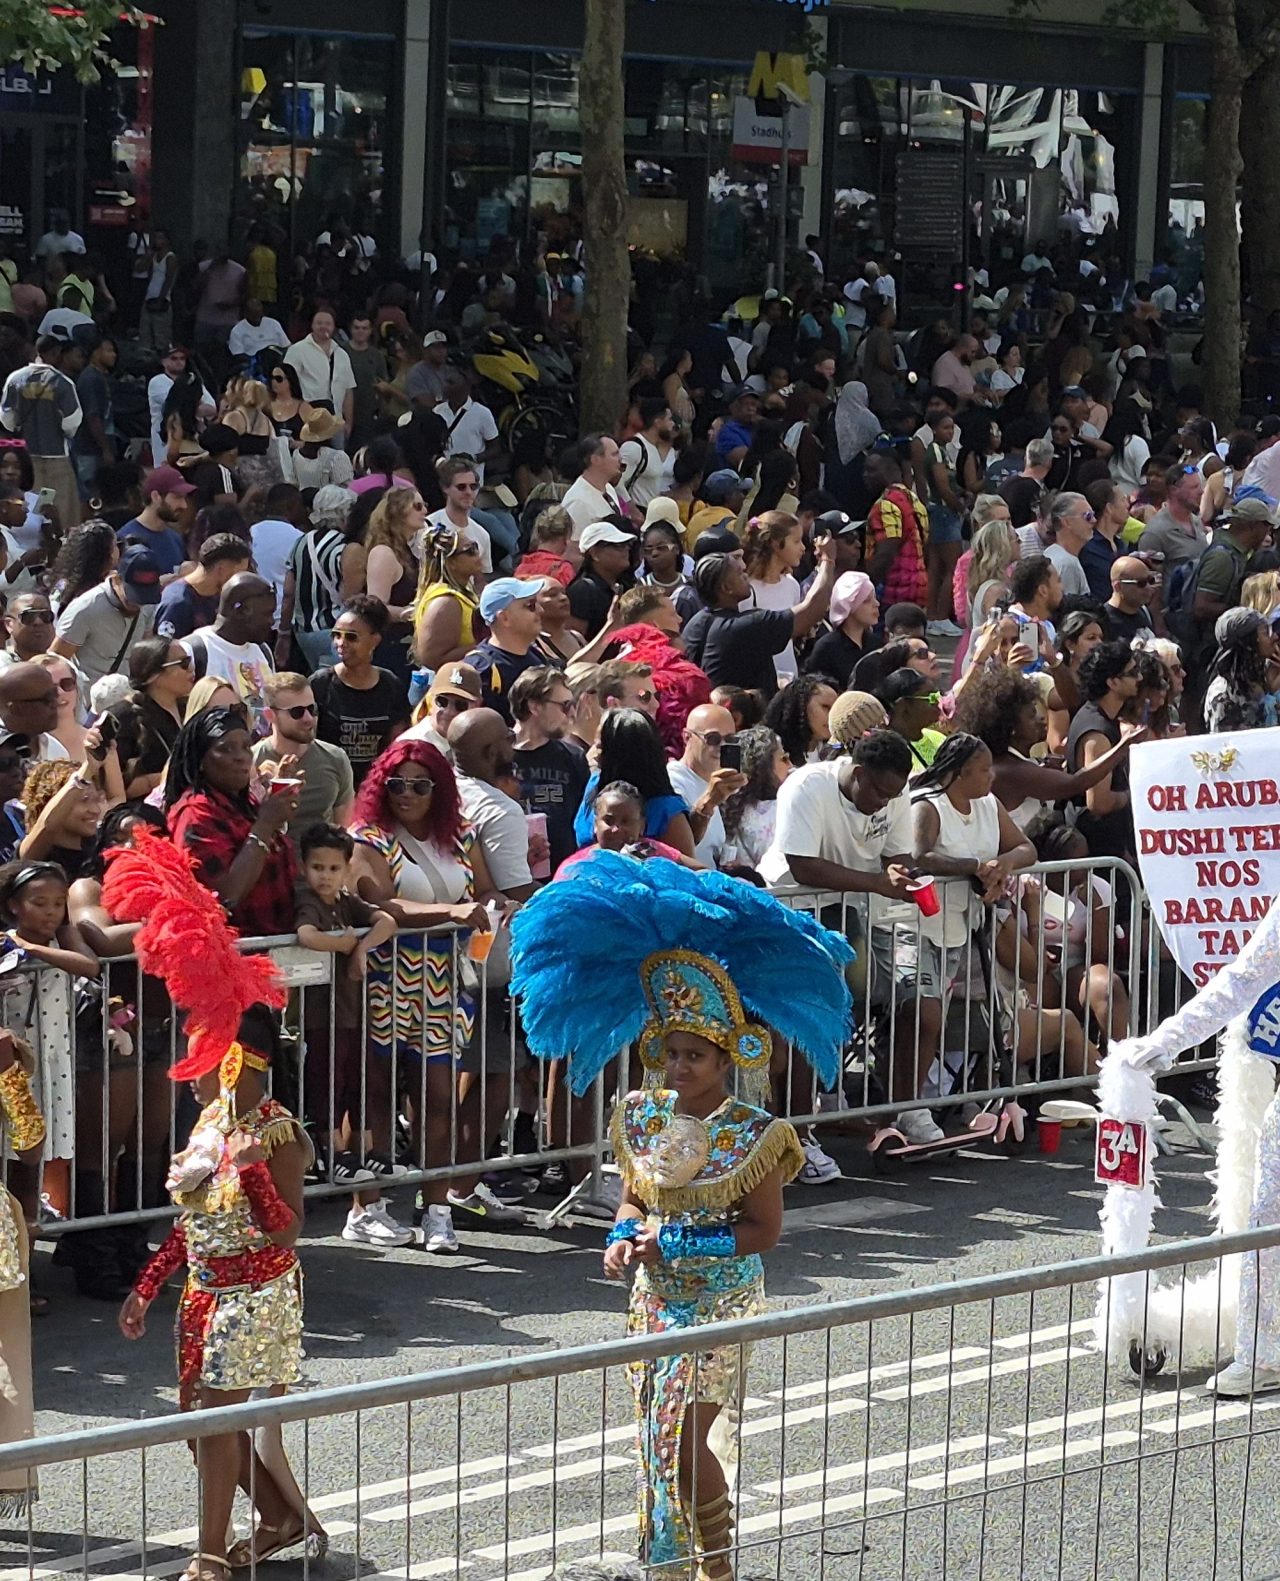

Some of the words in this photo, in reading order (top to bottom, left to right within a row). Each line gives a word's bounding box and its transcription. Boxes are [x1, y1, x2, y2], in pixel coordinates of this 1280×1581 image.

[751, 126, 792, 139] Stadhus
[530, 767, 570, 785] MILES
[1147, 785, 1187, 811] OH
[1139, 827, 1226, 856] DUSHI
[1196, 859, 1260, 887] NOS
[1164, 895, 1274, 925] BARAN
[1100, 1124, 1139, 1171] 3A
